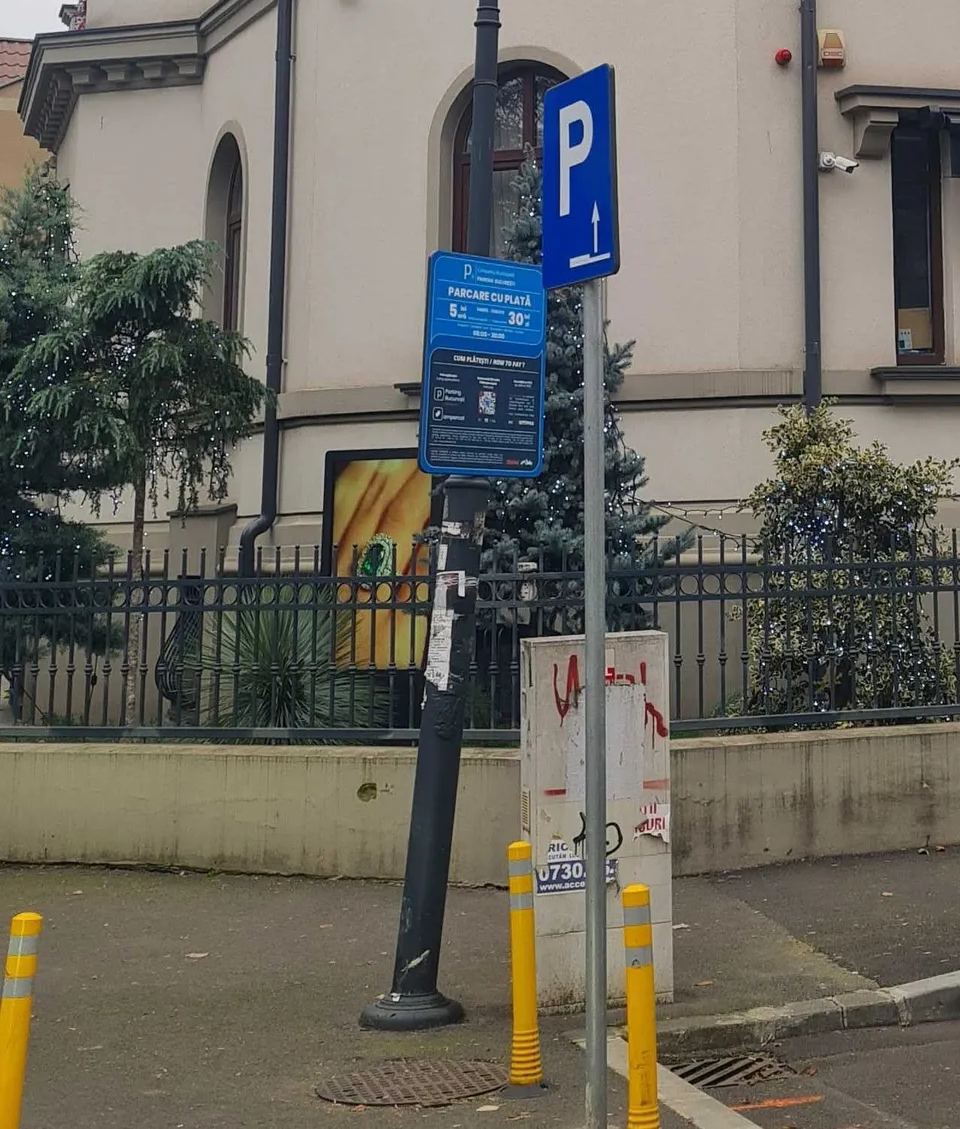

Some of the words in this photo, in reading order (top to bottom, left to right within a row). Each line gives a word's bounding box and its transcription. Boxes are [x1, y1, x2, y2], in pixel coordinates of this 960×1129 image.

[559, 100, 594, 217] P
[448, 286, 489, 301] PARCARE
[491, 292, 504, 303] CU
[504, 294, 531, 307] PLATĂ
[449, 303, 458, 318] 5
[508, 311, 524, 326] 30
